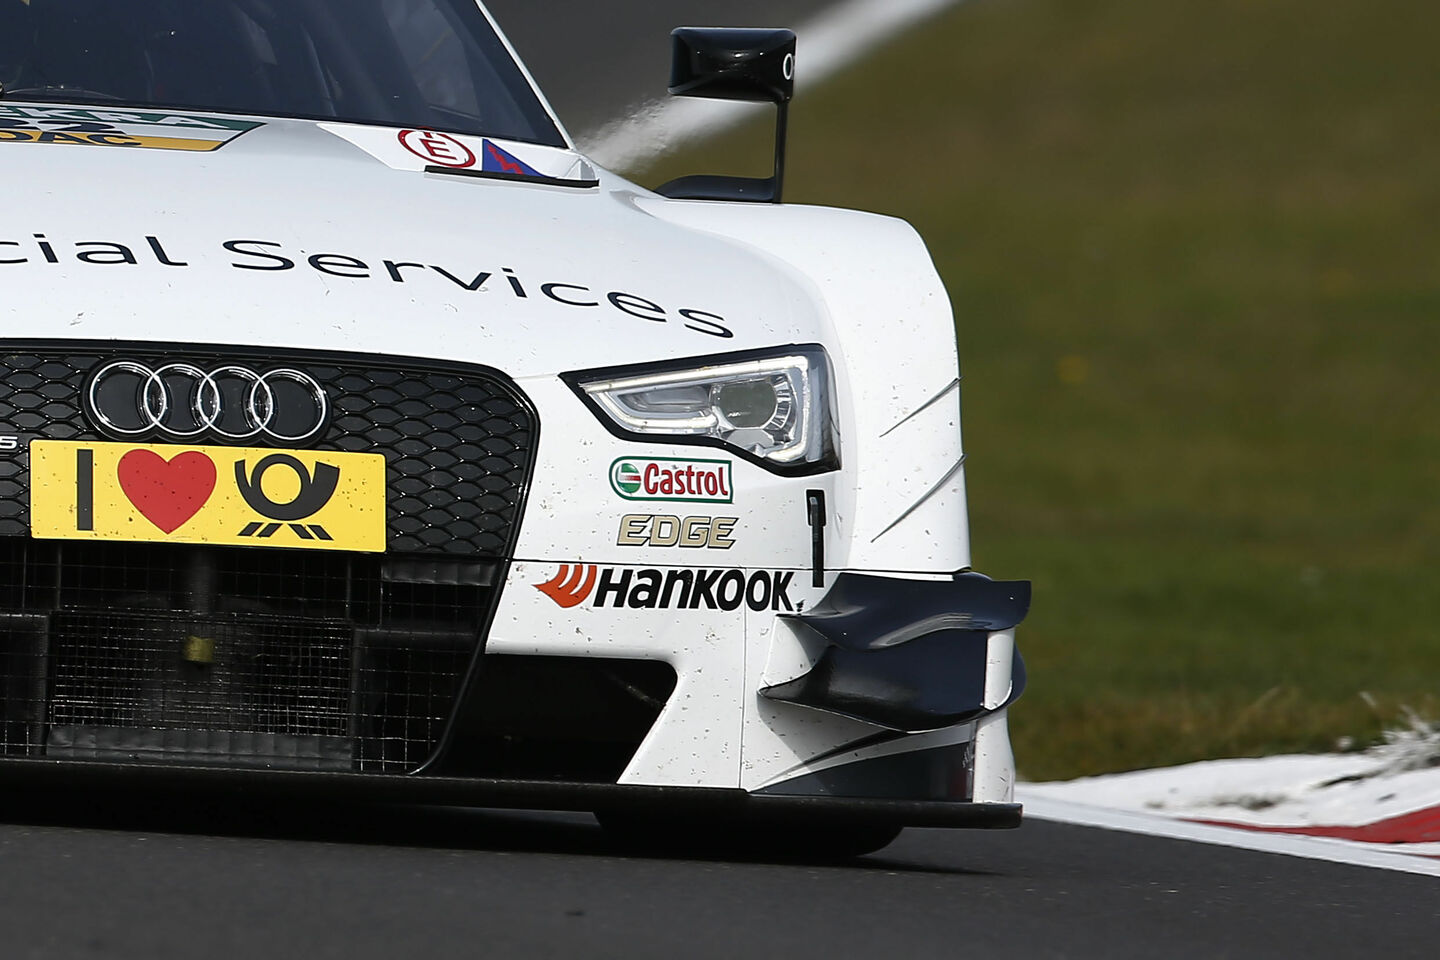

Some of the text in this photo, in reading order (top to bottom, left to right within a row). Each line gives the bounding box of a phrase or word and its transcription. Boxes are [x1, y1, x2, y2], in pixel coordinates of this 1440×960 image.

[222, 239, 734, 339] Services
[76, 448, 94, 531] I
[643, 462, 729, 496] Castrol
[617, 514, 739, 549] EDGE
